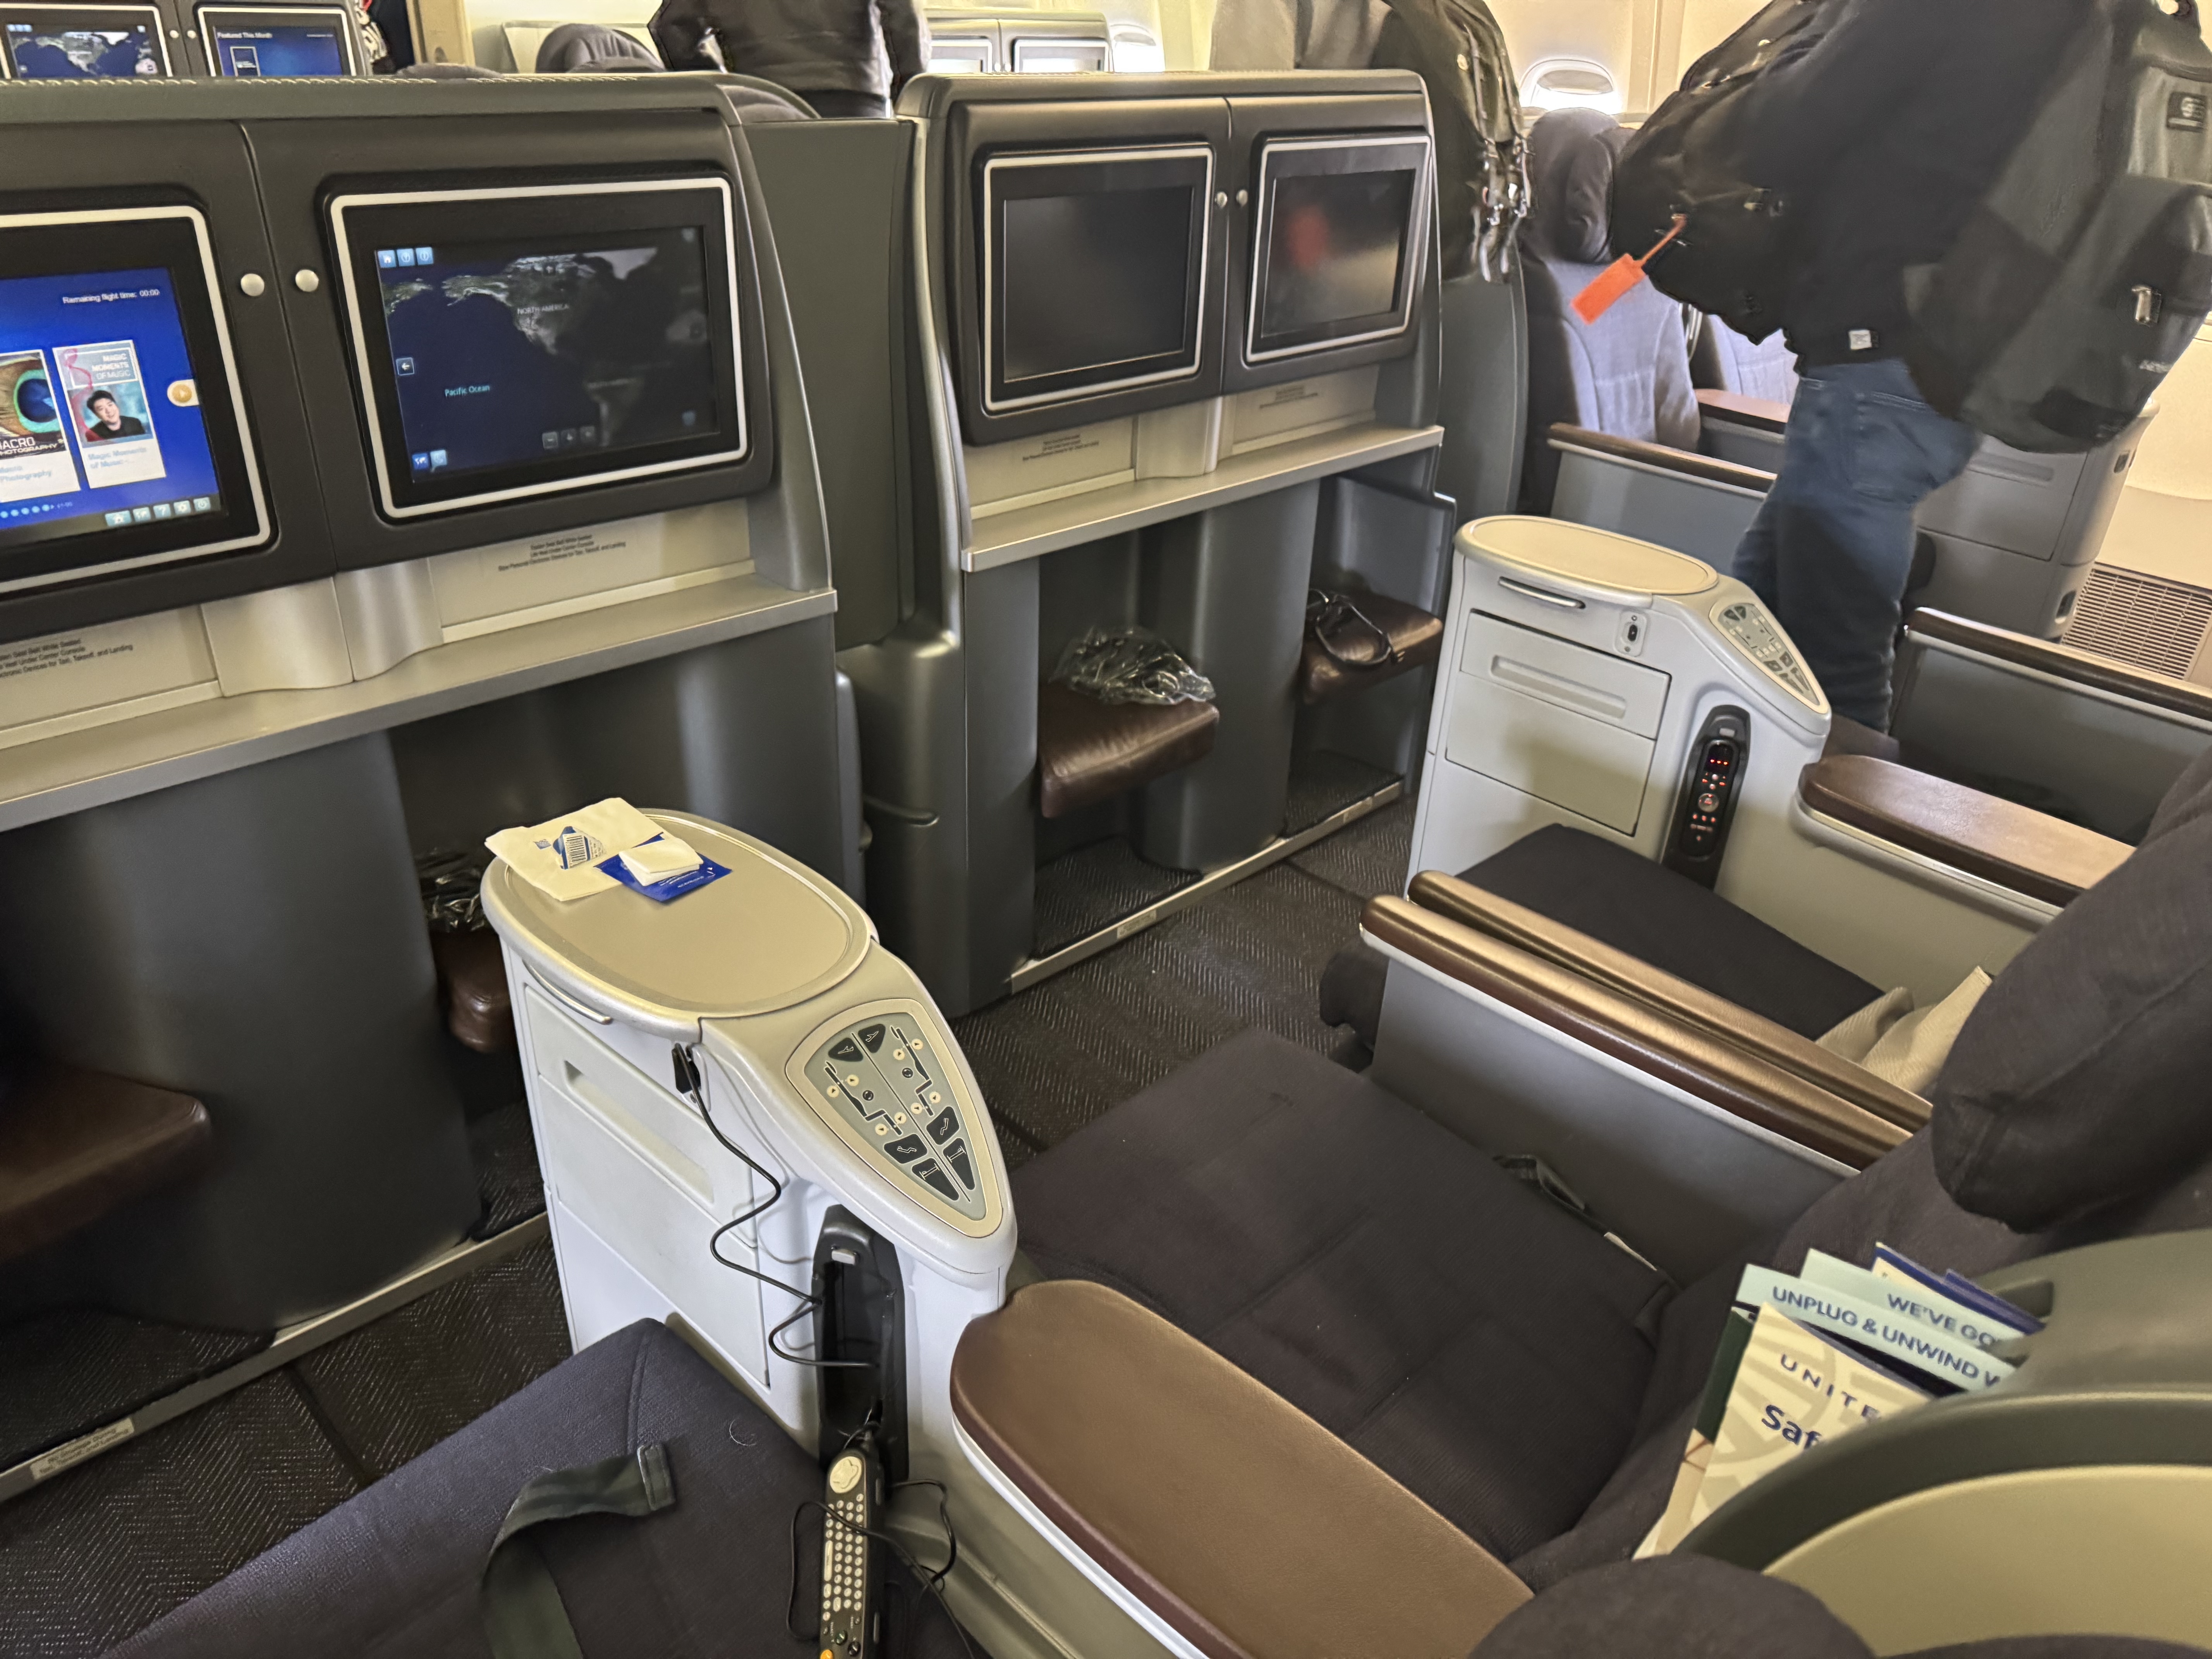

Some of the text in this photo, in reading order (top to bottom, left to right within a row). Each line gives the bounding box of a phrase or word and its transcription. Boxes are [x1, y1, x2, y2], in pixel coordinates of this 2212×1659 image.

[62, 295, 101, 304] Remaining
[101, 293, 119, 301] flight
[139, 289, 160, 297] 00:00
[517, 304, 570, 314] NORTH AMERICA
[103, 353, 128, 362] MAGIC
[445, 385, 490, 398] Pacific Ocean
[1887, 1293, 1957, 1333] WE'VE
[1773, 1286, 1858, 1326] UNPLUG
[1862, 1318, 1877, 1335] &
[1883, 1325, 1980, 1379] UNWIND
